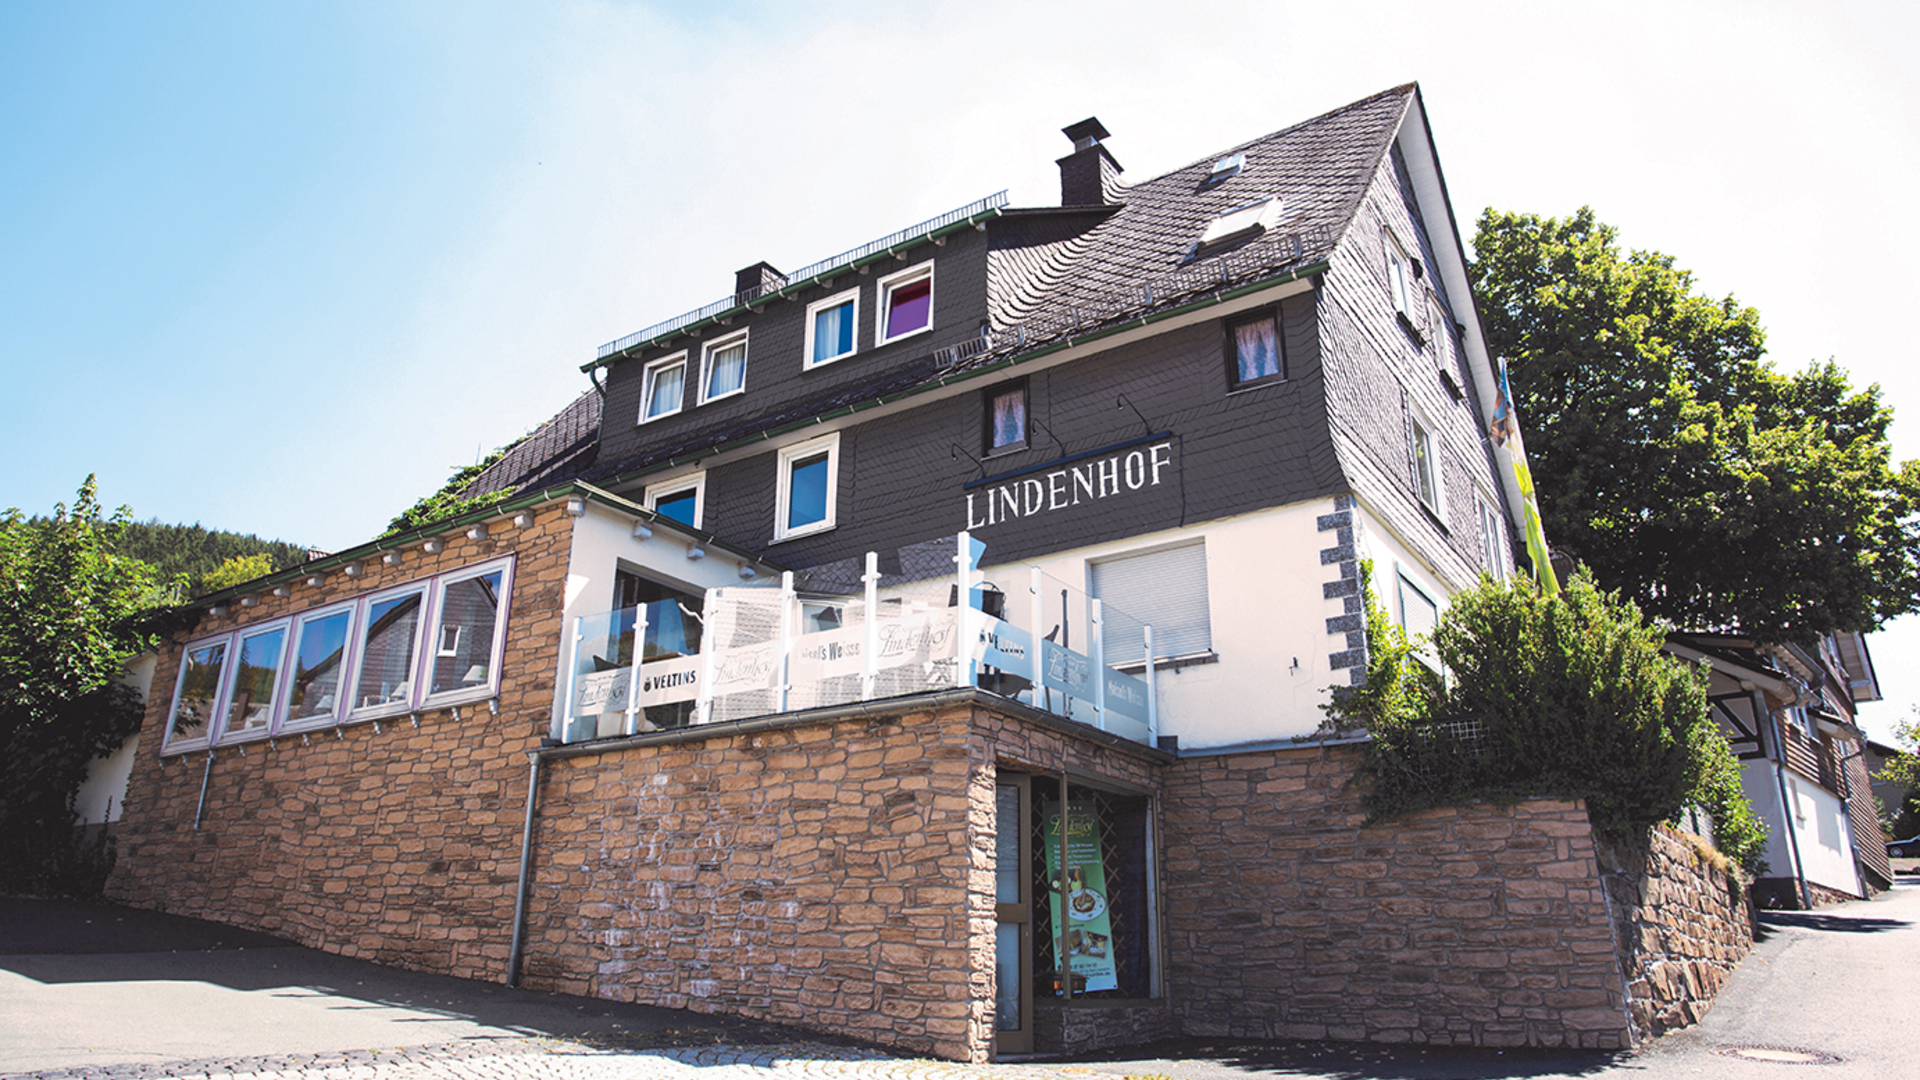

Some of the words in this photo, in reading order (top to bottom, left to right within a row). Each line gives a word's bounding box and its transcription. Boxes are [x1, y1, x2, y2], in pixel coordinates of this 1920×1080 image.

[966, 442, 1172, 531] LINDENHOF
[877, 621, 955, 659] Lindenhof
[653, 670, 696, 690] VELTINS
